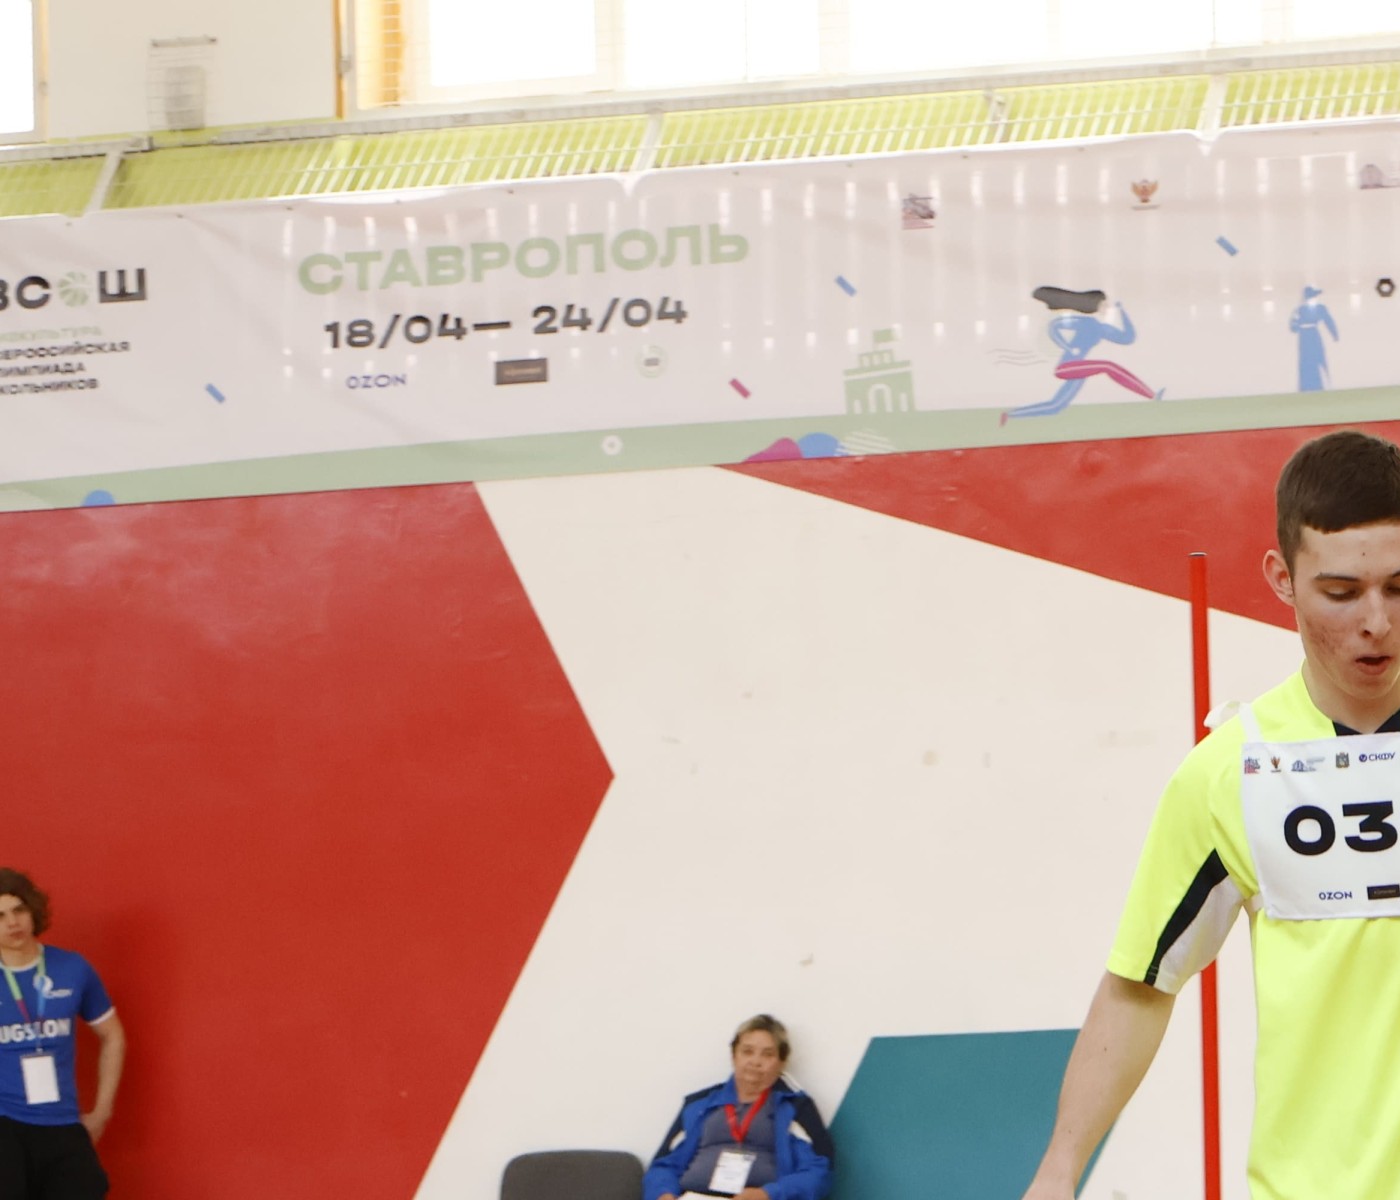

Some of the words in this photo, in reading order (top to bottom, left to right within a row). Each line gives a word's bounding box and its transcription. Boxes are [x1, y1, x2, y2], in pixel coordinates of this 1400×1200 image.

[299, 222, 749, 295] СТАВРОПОЛЬ
[532, 296, 687, 335] 24/04
[346, 373, 407, 389] OZON
[1318, 891, 1353, 901] OZON
